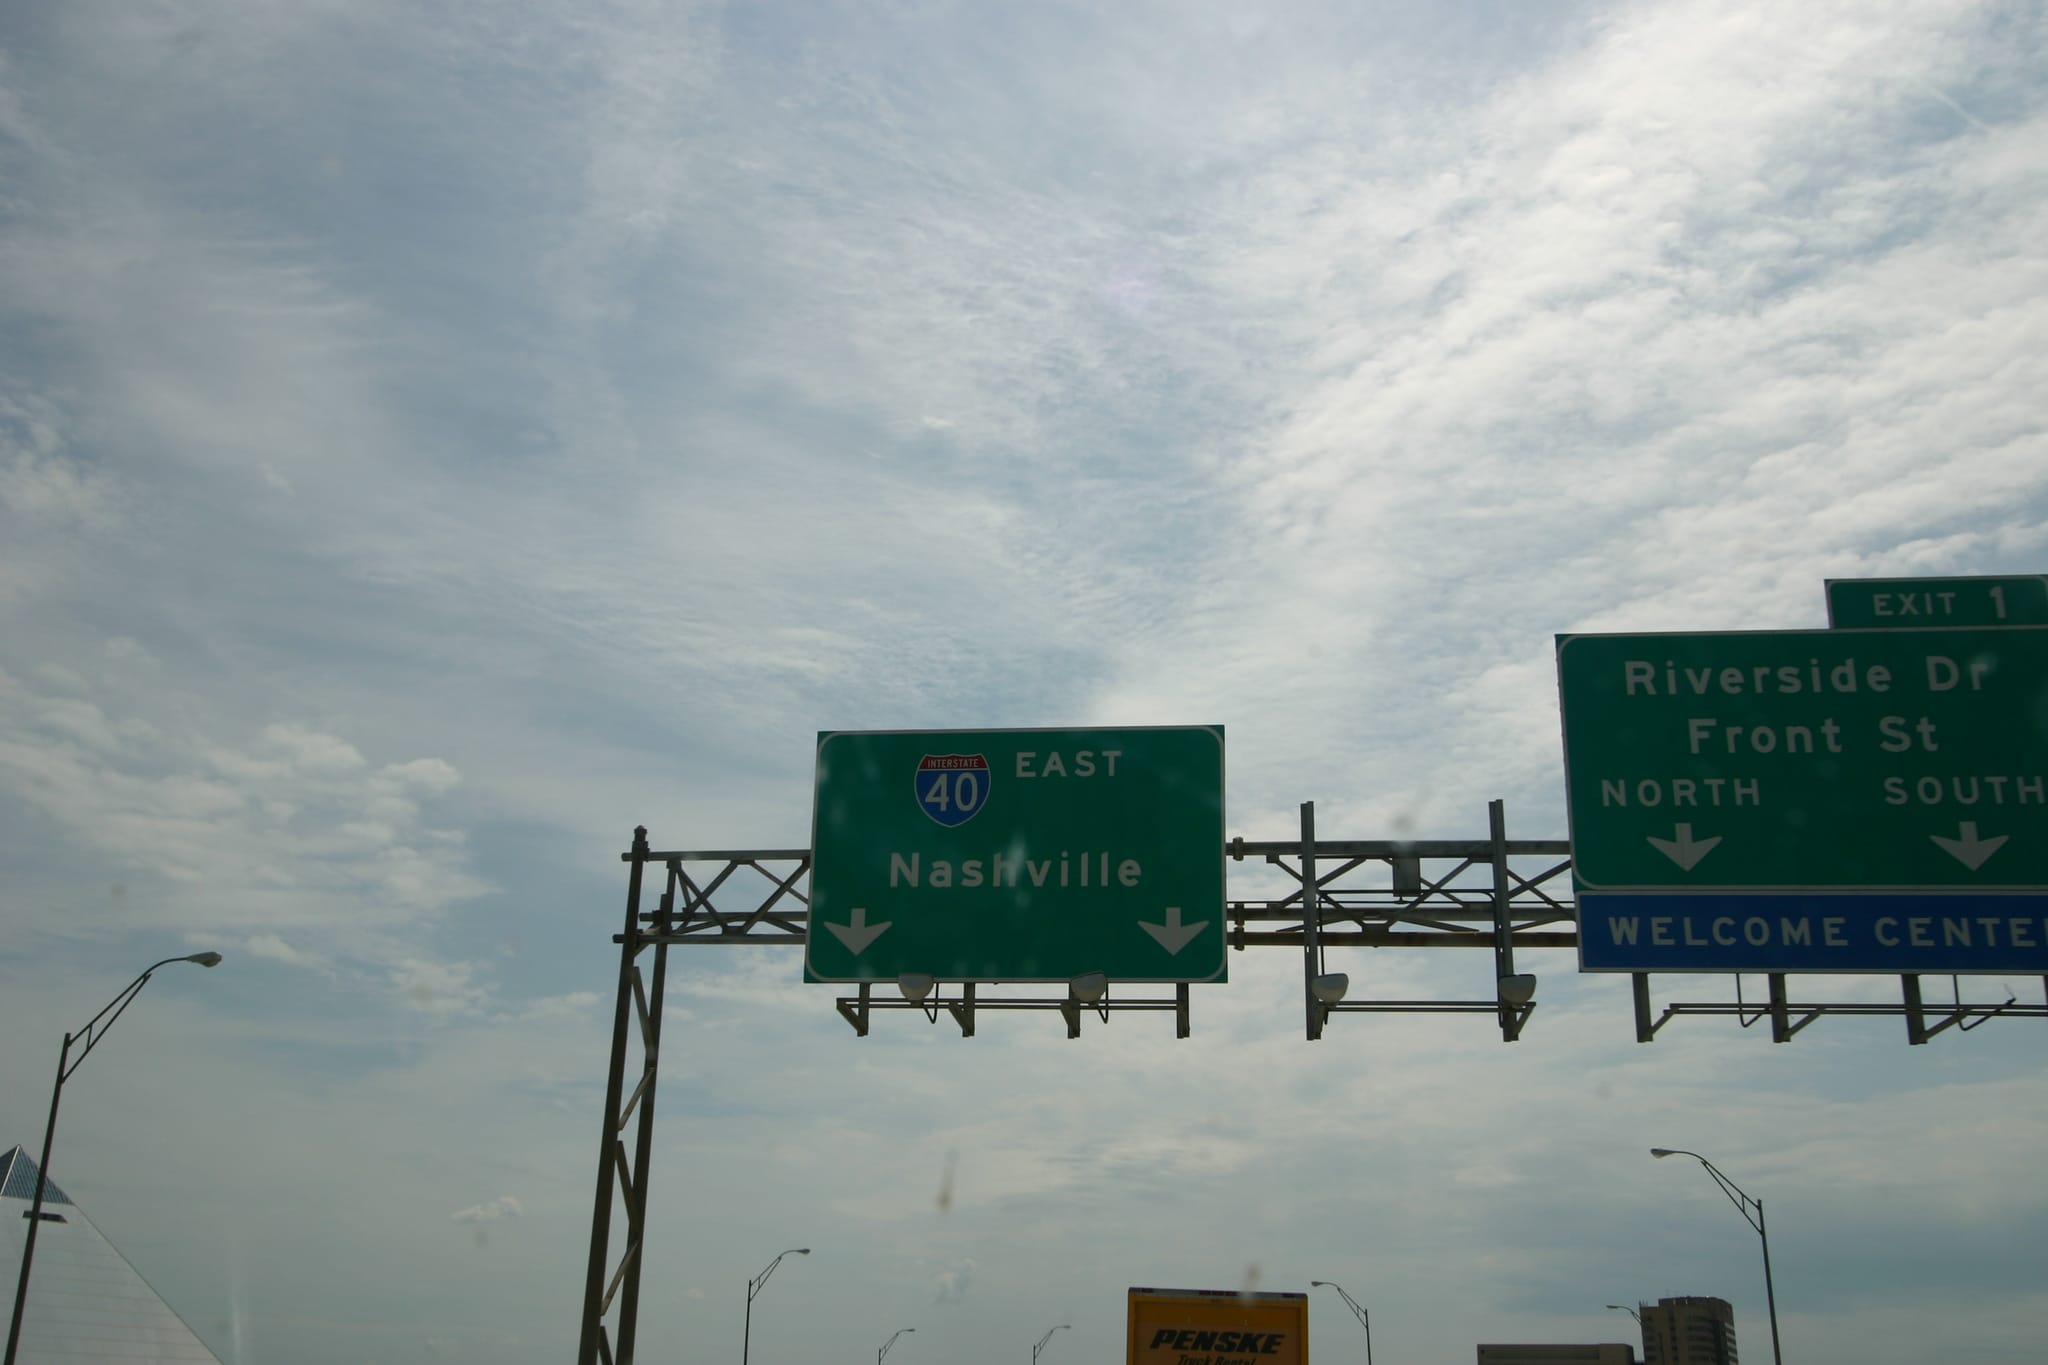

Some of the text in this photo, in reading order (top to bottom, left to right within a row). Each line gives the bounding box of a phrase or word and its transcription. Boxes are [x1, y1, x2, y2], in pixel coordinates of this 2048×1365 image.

[1873, 586, 2007, 619] EXIT 1
[1624, 655, 1988, 696] Riverside Dr
[1688, 716, 1939, 754] Front St
[927, 757, 980, 769] INTERSTATE
[1015, 750, 1122, 778] EAST
[924, 772, 978, 812] 40
[1601, 776, 2046, 807] NORTH SOUTH
[889, 851, 1143, 888] Nashville
[1608, 916, 2048, 948] WELCOME CENTE
[1150, 1328, 1286, 1355] PENSKE
[1177, 1354, 1212, 1365] Truck
